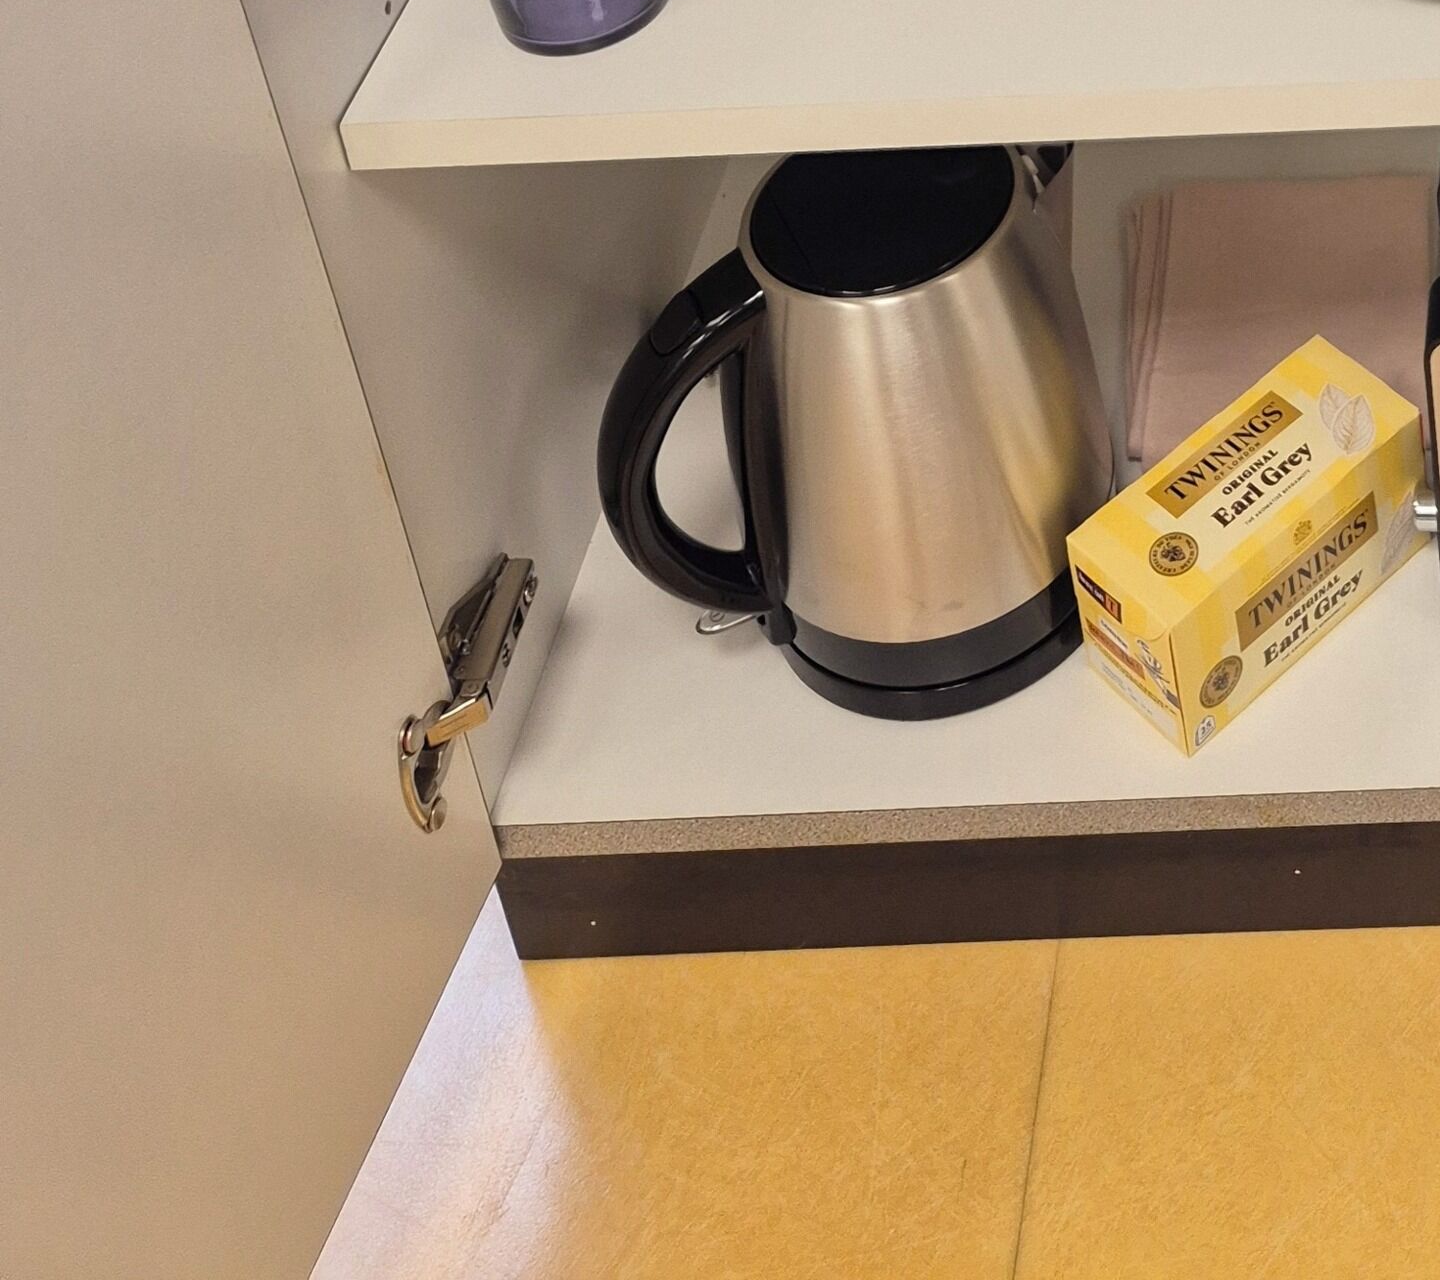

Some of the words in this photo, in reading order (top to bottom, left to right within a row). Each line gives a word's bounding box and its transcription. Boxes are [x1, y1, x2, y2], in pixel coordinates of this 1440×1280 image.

[1164, 401, 1284, 500] TWININGS
[1210, 481, 1265, 528] Earl
[1260, 442, 1313, 487] Grey
[1213, 471, 1226, 481] OF
[1228, 442, 1262, 471] LONDON
[1221, 449, 1279, 496] ORIGINAL
[1248, 512, 1368, 628] TWININGS
[1285, 574, 1341, 627] ORIGINAL
[1263, 614, 1309, 668] Earl
[1314, 569, 1363, 621] Grey
